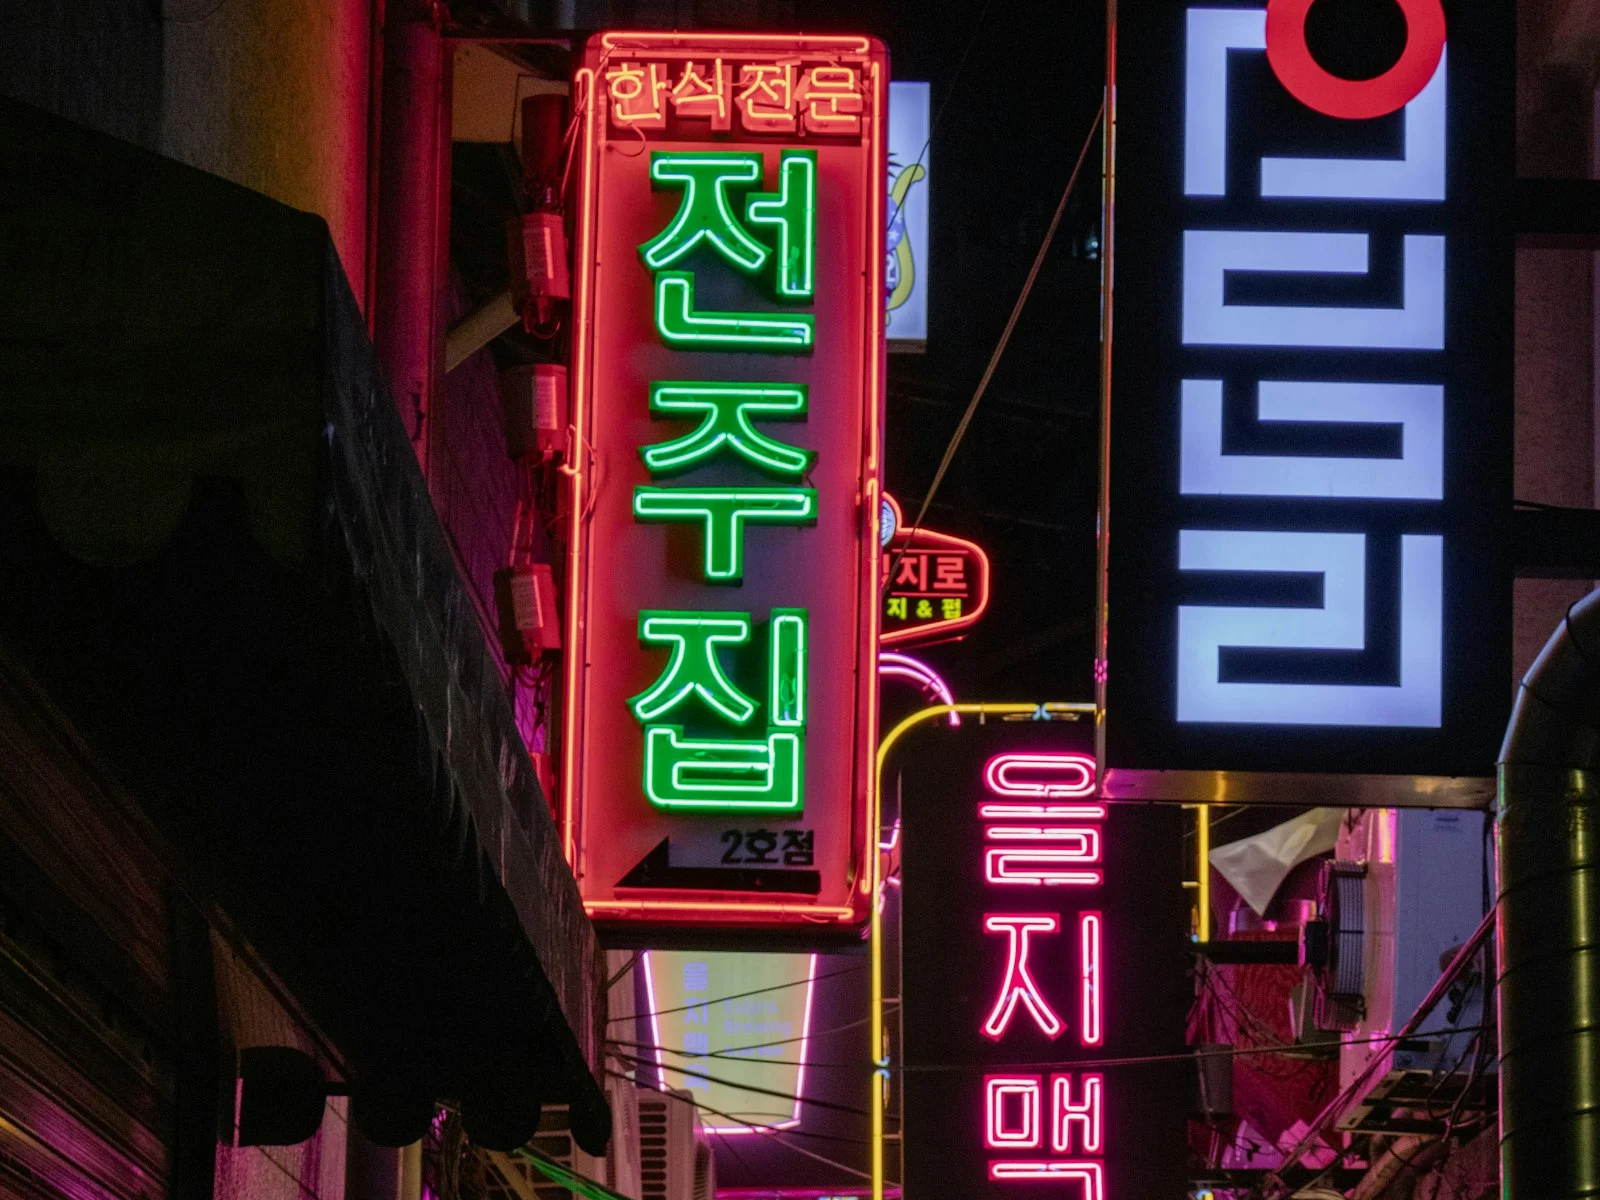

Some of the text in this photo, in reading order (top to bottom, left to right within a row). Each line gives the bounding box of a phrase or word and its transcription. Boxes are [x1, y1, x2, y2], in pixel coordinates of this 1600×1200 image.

[605, 58, 862, 122] 한식전문
[626, 149, 818, 813] 전주집
[720, 829, 814, 866] 2호점
